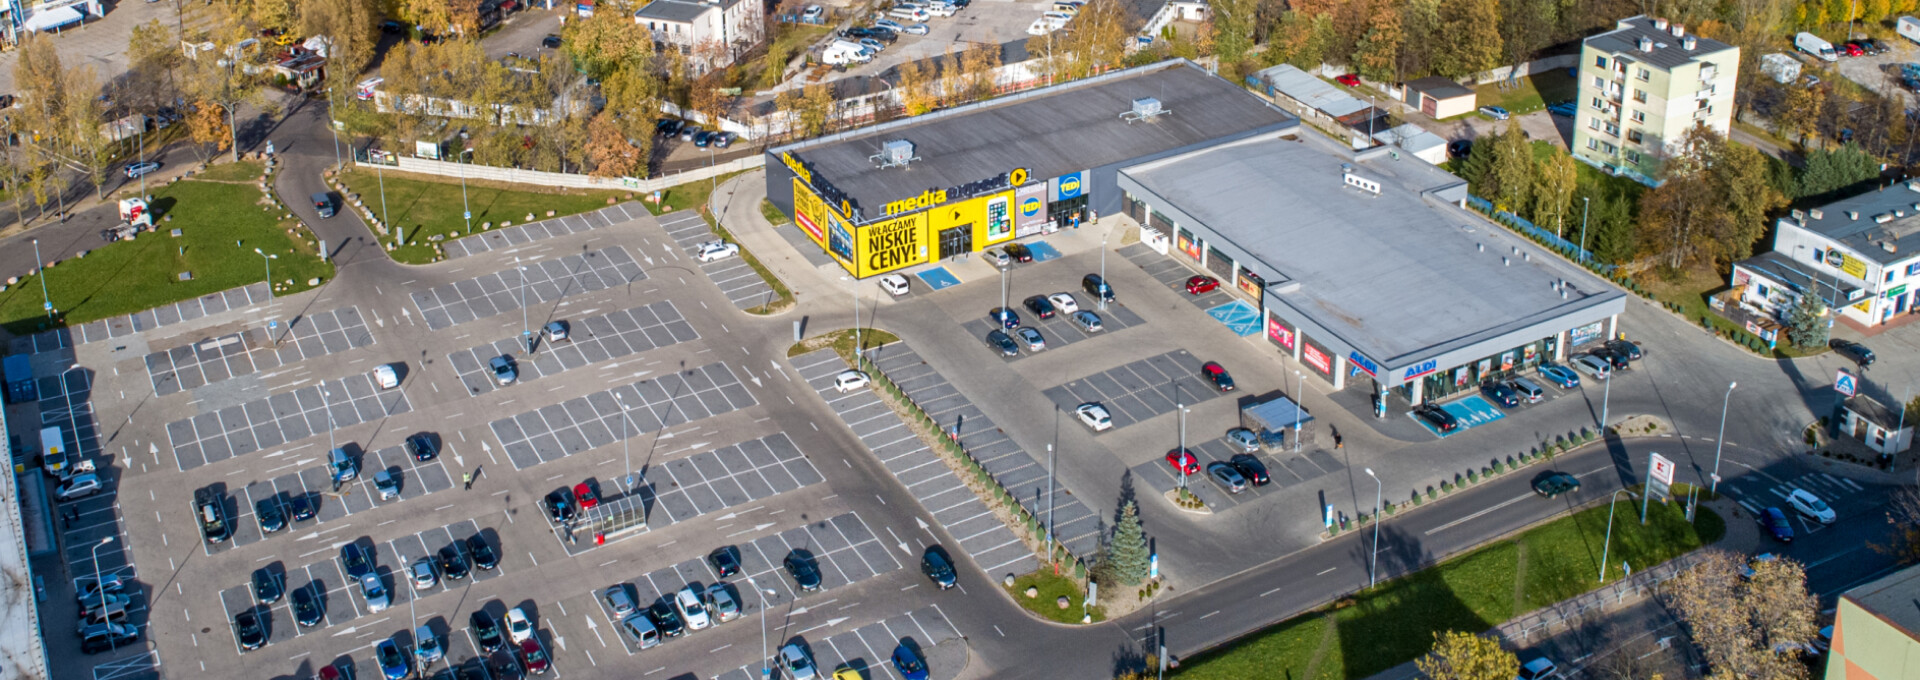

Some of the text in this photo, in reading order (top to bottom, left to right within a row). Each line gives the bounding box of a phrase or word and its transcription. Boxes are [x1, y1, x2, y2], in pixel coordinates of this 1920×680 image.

[869, 227, 917, 253] NISKIE
[869, 243, 917, 270] CENY!
[1349, 351, 1378, 374] ALDI
[1404, 359, 1437, 378] ALDI
